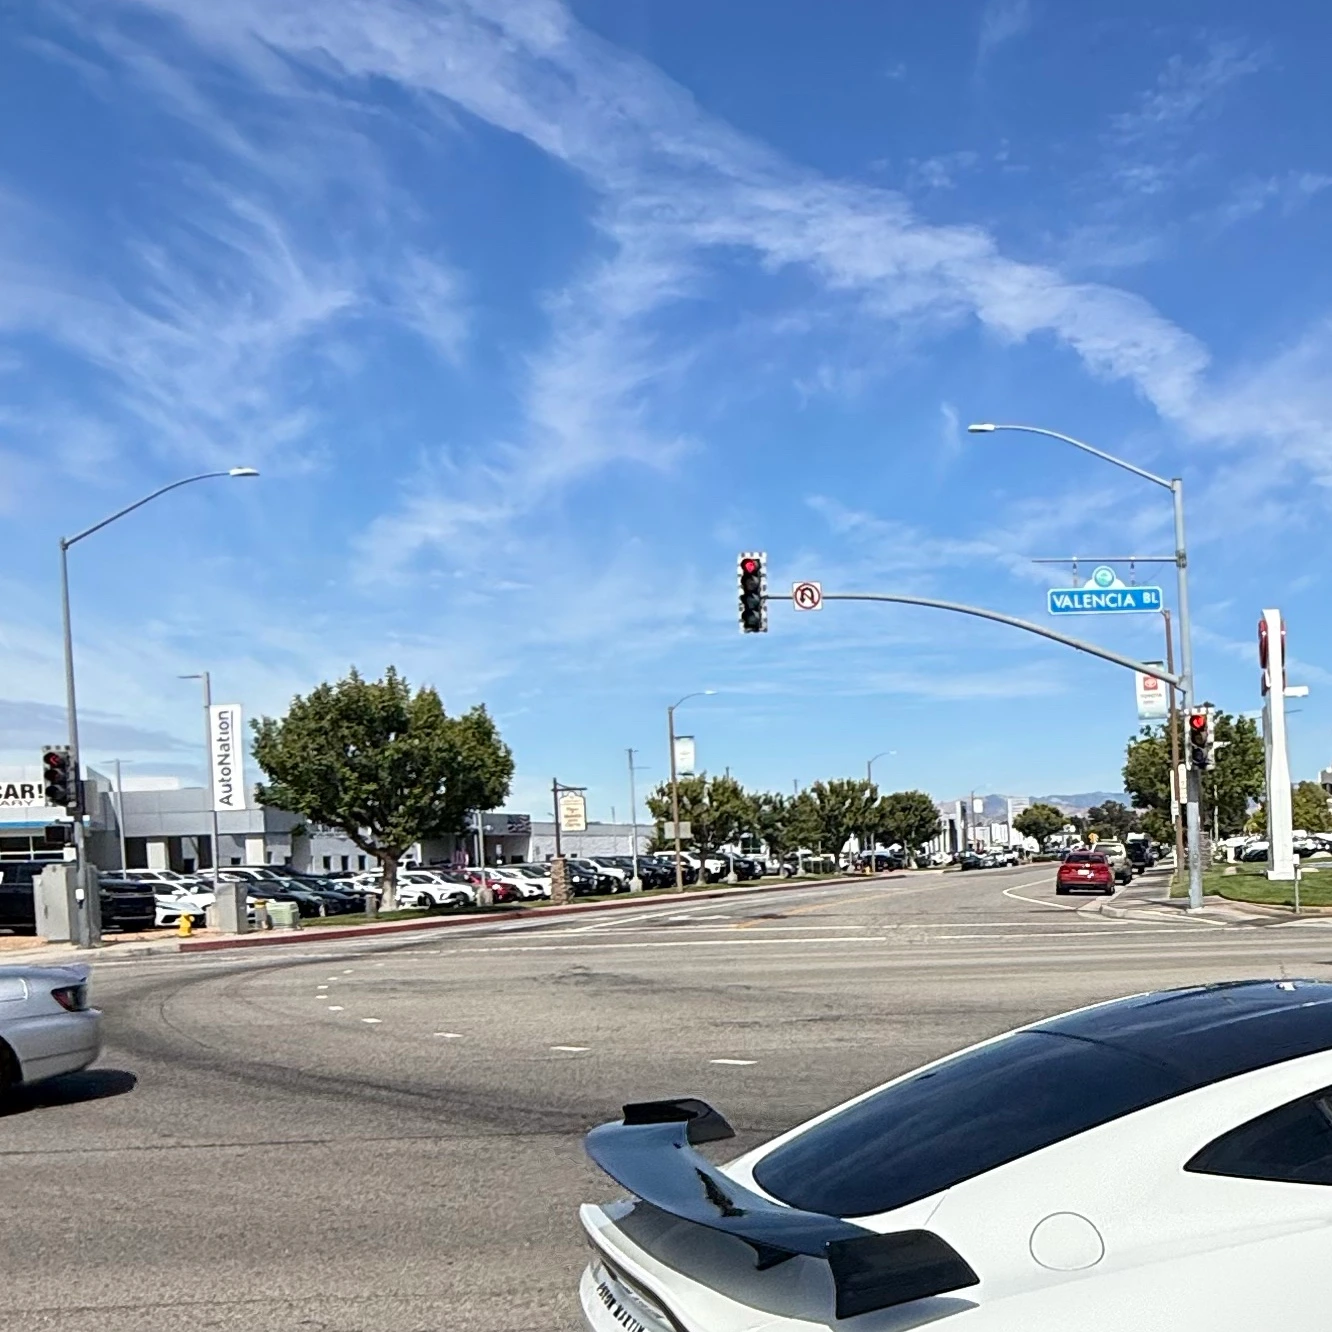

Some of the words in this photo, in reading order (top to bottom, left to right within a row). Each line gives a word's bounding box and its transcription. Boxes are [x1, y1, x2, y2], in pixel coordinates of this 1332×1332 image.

[1052, 593, 1136, 609] VALENCIA
[1142, 592, 1159, 604] BL
[216, 710, 234, 806] AutoNation
[0, 783, 43, 799] AR!
